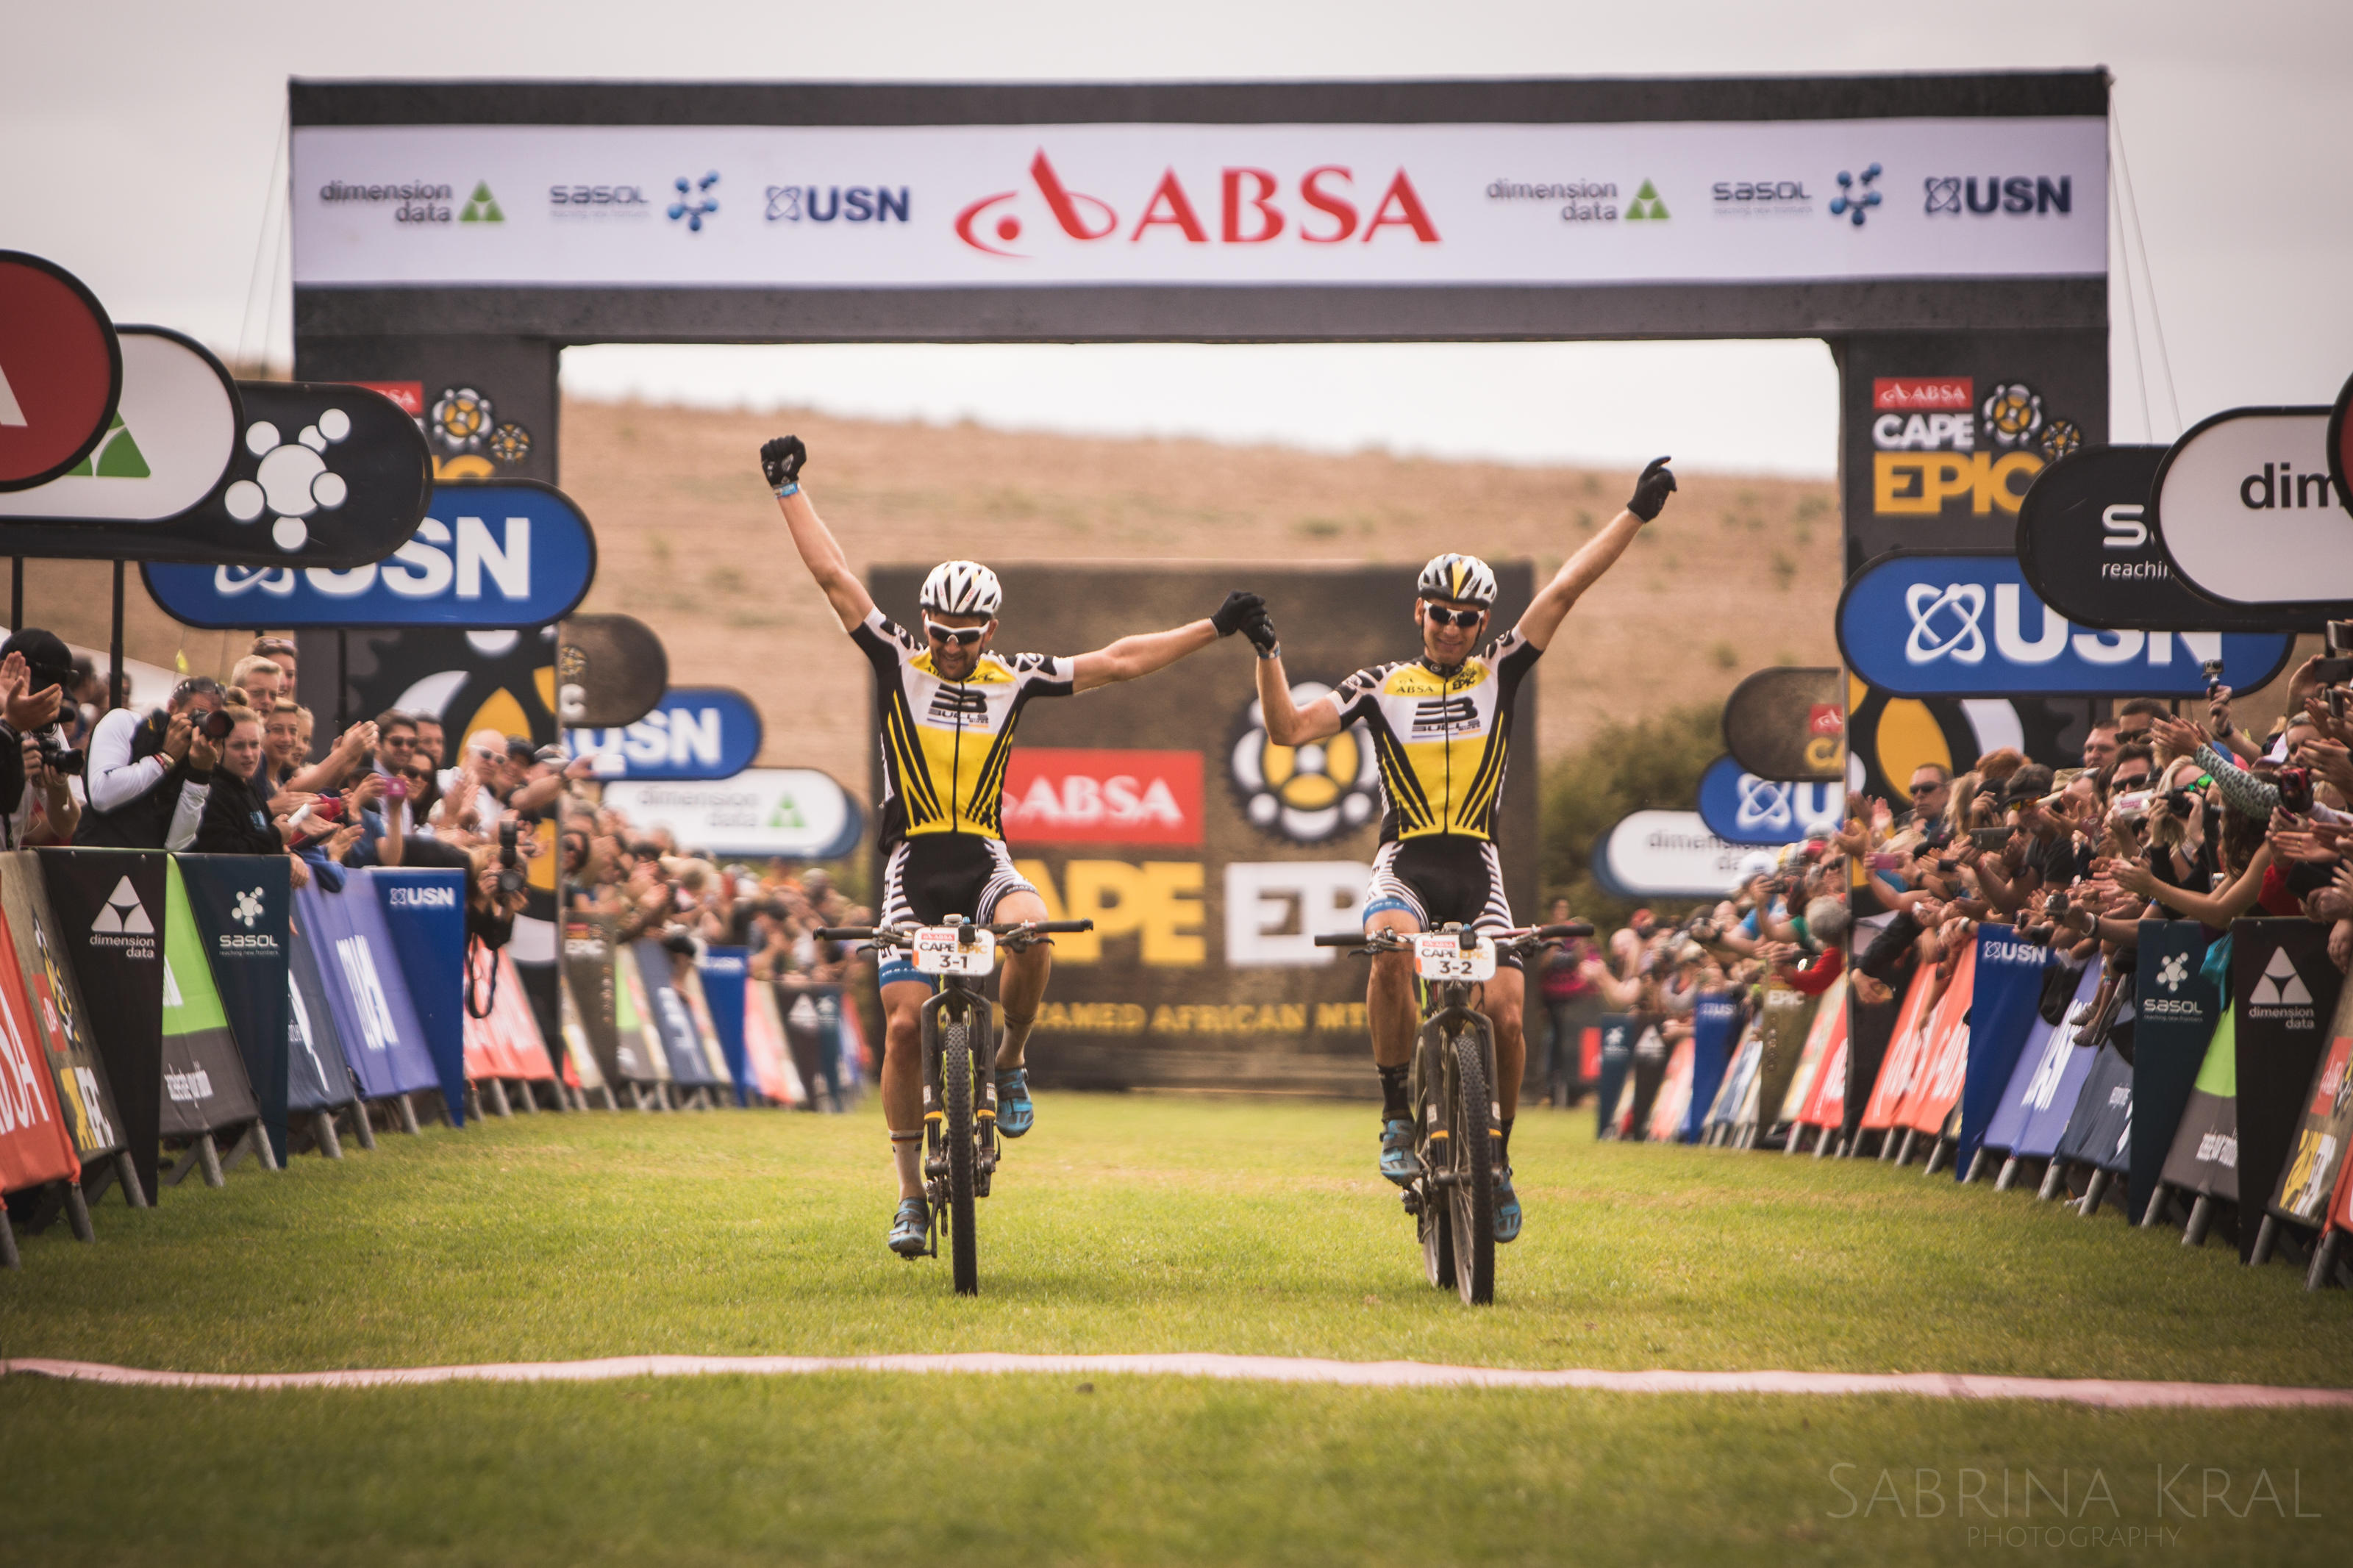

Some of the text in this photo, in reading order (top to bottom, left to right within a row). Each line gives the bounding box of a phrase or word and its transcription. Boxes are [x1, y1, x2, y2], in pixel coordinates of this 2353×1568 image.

[319, 180, 452, 201] dimension
[1486, 178, 1618, 198] dimension
[1965, 174, 2072, 213] USN
[395, 201, 451, 222] data
[807, 185, 909, 222] USN
[1129, 163, 1443, 244] ABSA
[1561, 199, 1618, 221] data
[1910, 384, 1967, 400] ABSA
[1873, 413, 1974, 450] CAPE
[1874, 451, 2045, 516] EPIC
[1396, 685, 1434, 693] ABSA
[1018, 775, 1185, 826] ABSA
[407, 887, 454, 905] USN
[90, 935, 155, 947] dimension
[920, 942, 954, 952] CAPE
[126, 947, 155, 959] data
[940, 955, 968, 969] 3-1
[1421, 949, 1456, 958] CAPE
[2001, 942, 2047, 964] USN
[1440, 961, 1472, 975] 3-2
[2249, 1006, 2314, 1018] dimension
[2286, 1017, 2314, 1029] data
